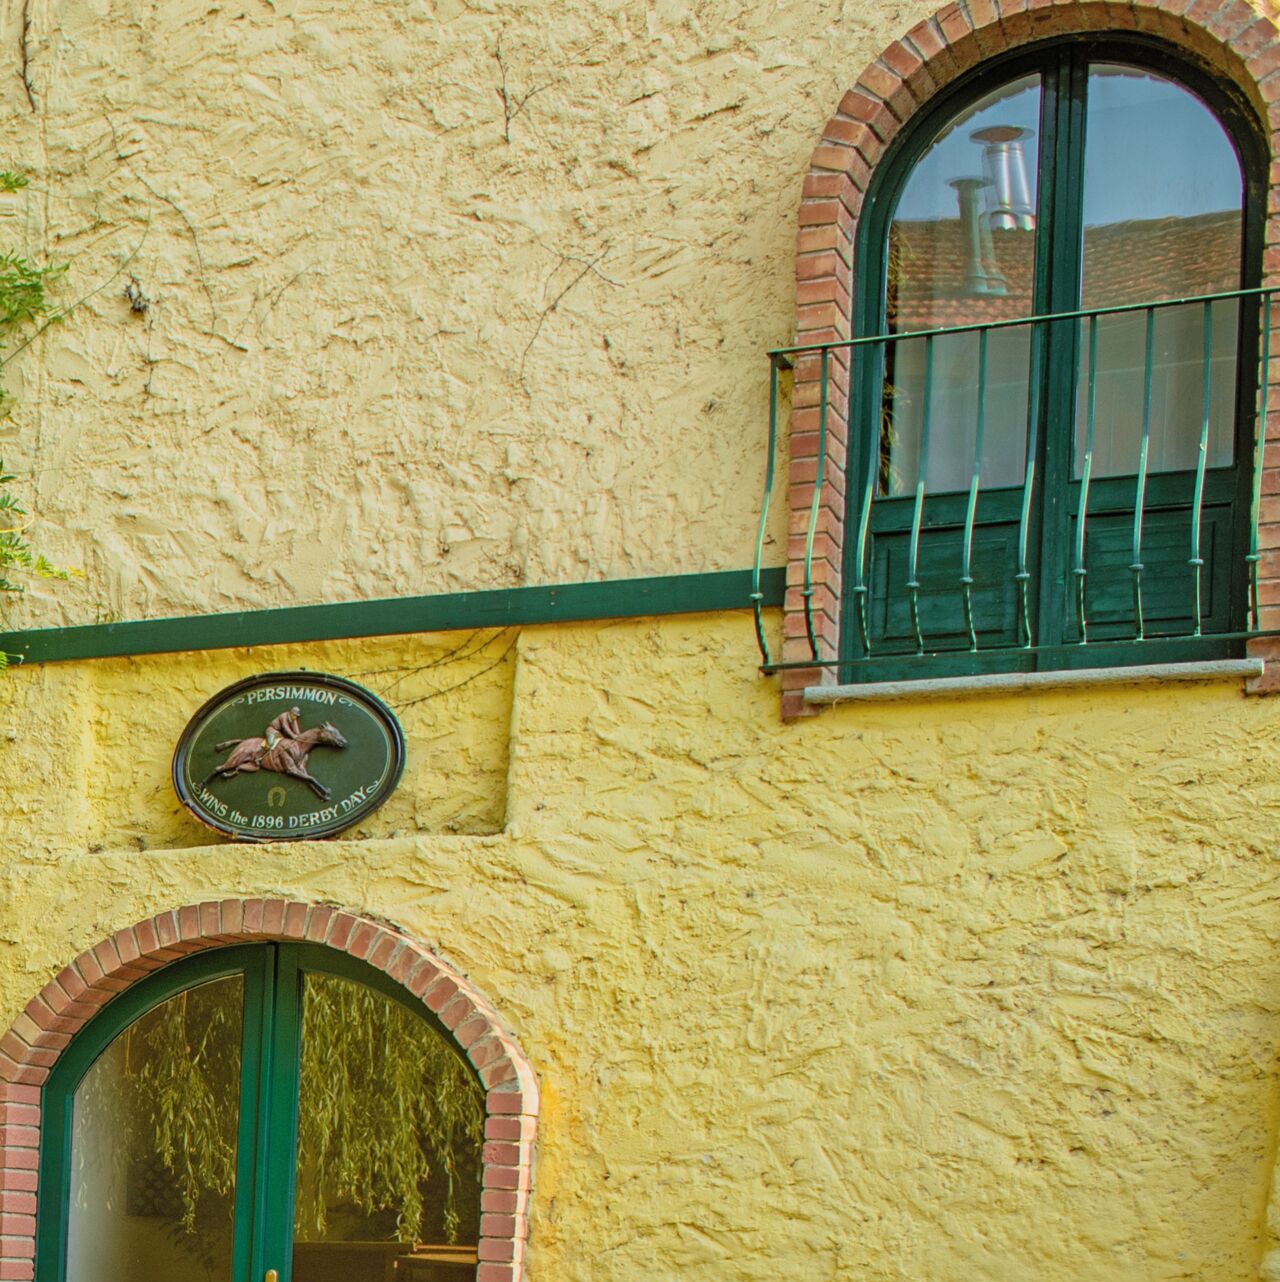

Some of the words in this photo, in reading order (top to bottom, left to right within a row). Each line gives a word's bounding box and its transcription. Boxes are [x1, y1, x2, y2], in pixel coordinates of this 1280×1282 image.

[247, 687, 337, 705] PERSIMMON
[199, 789, 227, 817] WINS
[230, 810, 248, 825] the
[251, 815, 284, 828] 1896
[289, 804, 339, 828] DERBY
[343, 786, 368, 813] DAY
